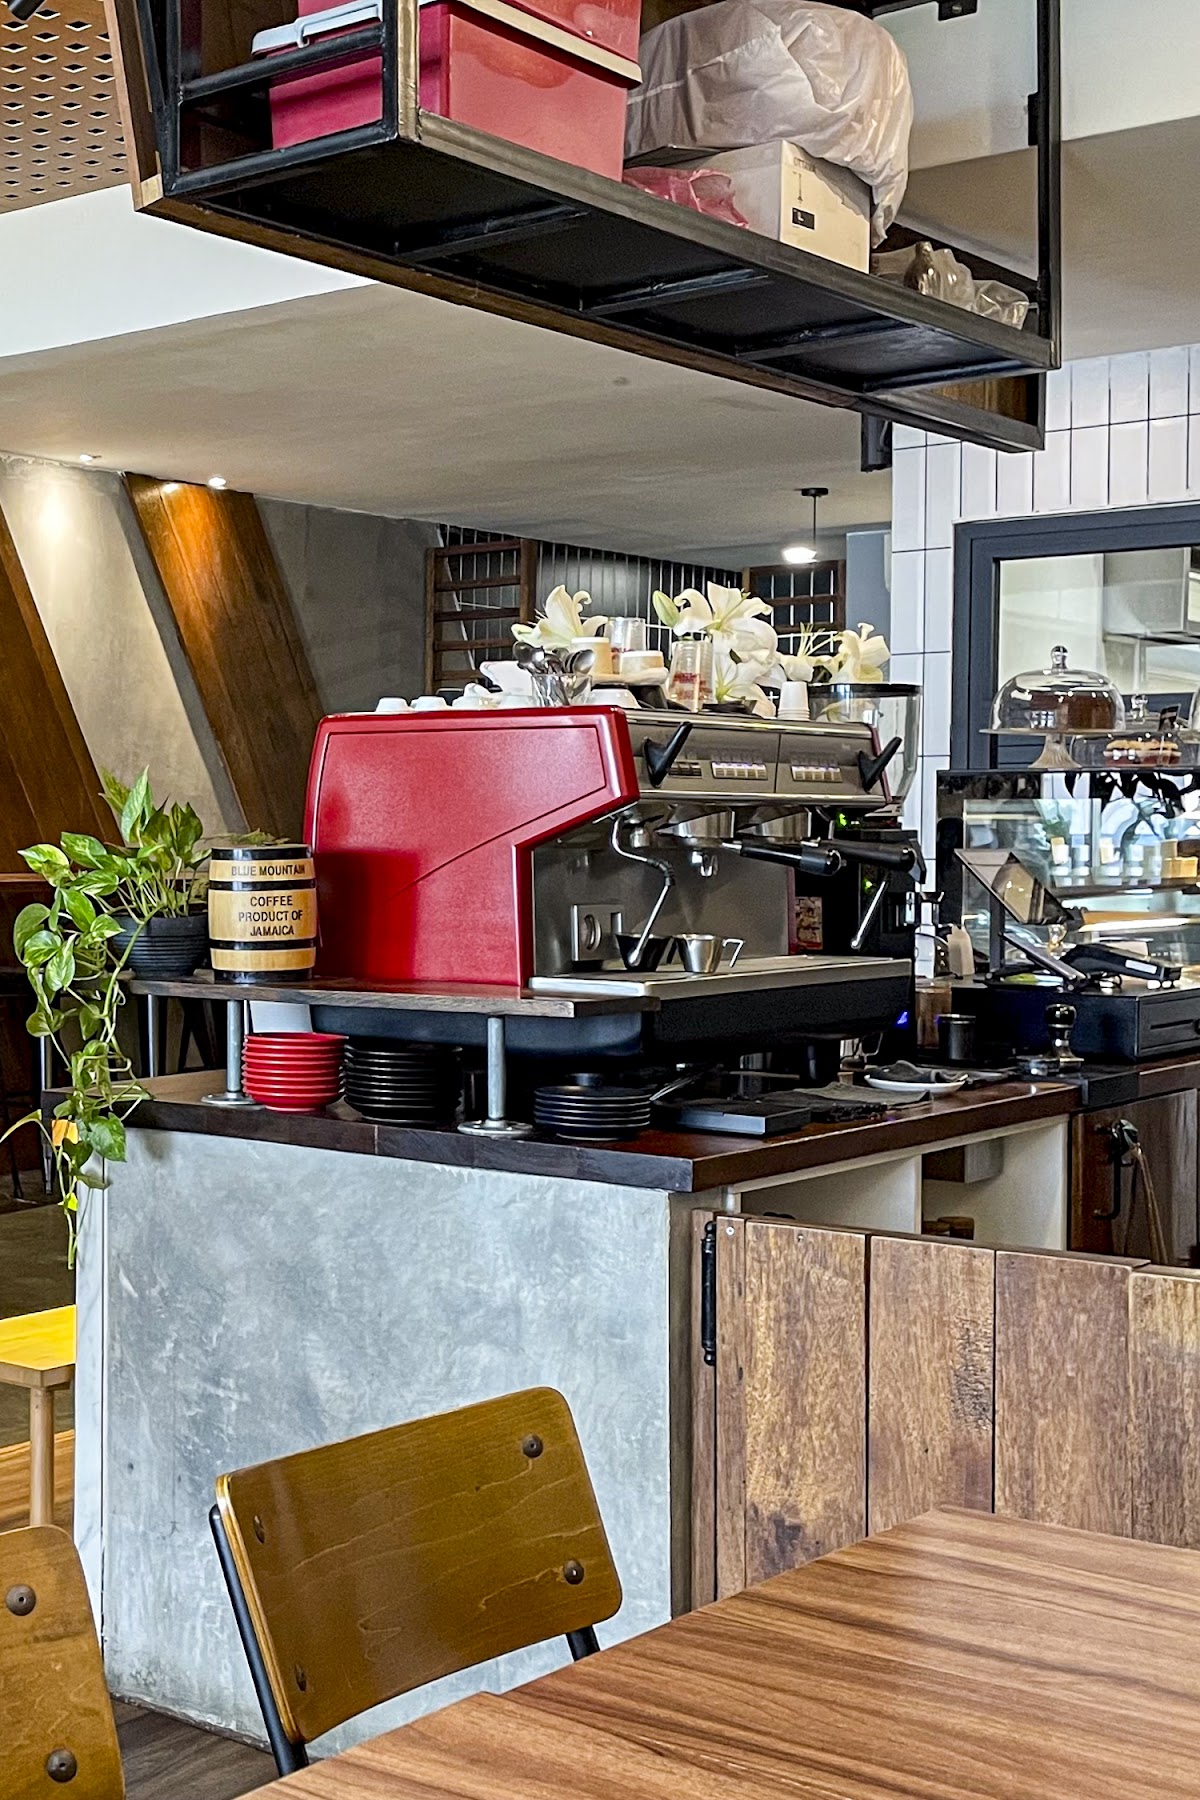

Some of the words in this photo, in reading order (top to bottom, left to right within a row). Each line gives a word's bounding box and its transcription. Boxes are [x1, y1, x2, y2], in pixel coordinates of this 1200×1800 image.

[231, 865, 257, 876] BLUE
[250, 895, 293, 907] COFFEE
[238, 911, 289, 922] PRODUCT
[291, 910, 303, 921] OF
[250, 925, 295, 937] JAMAICA
